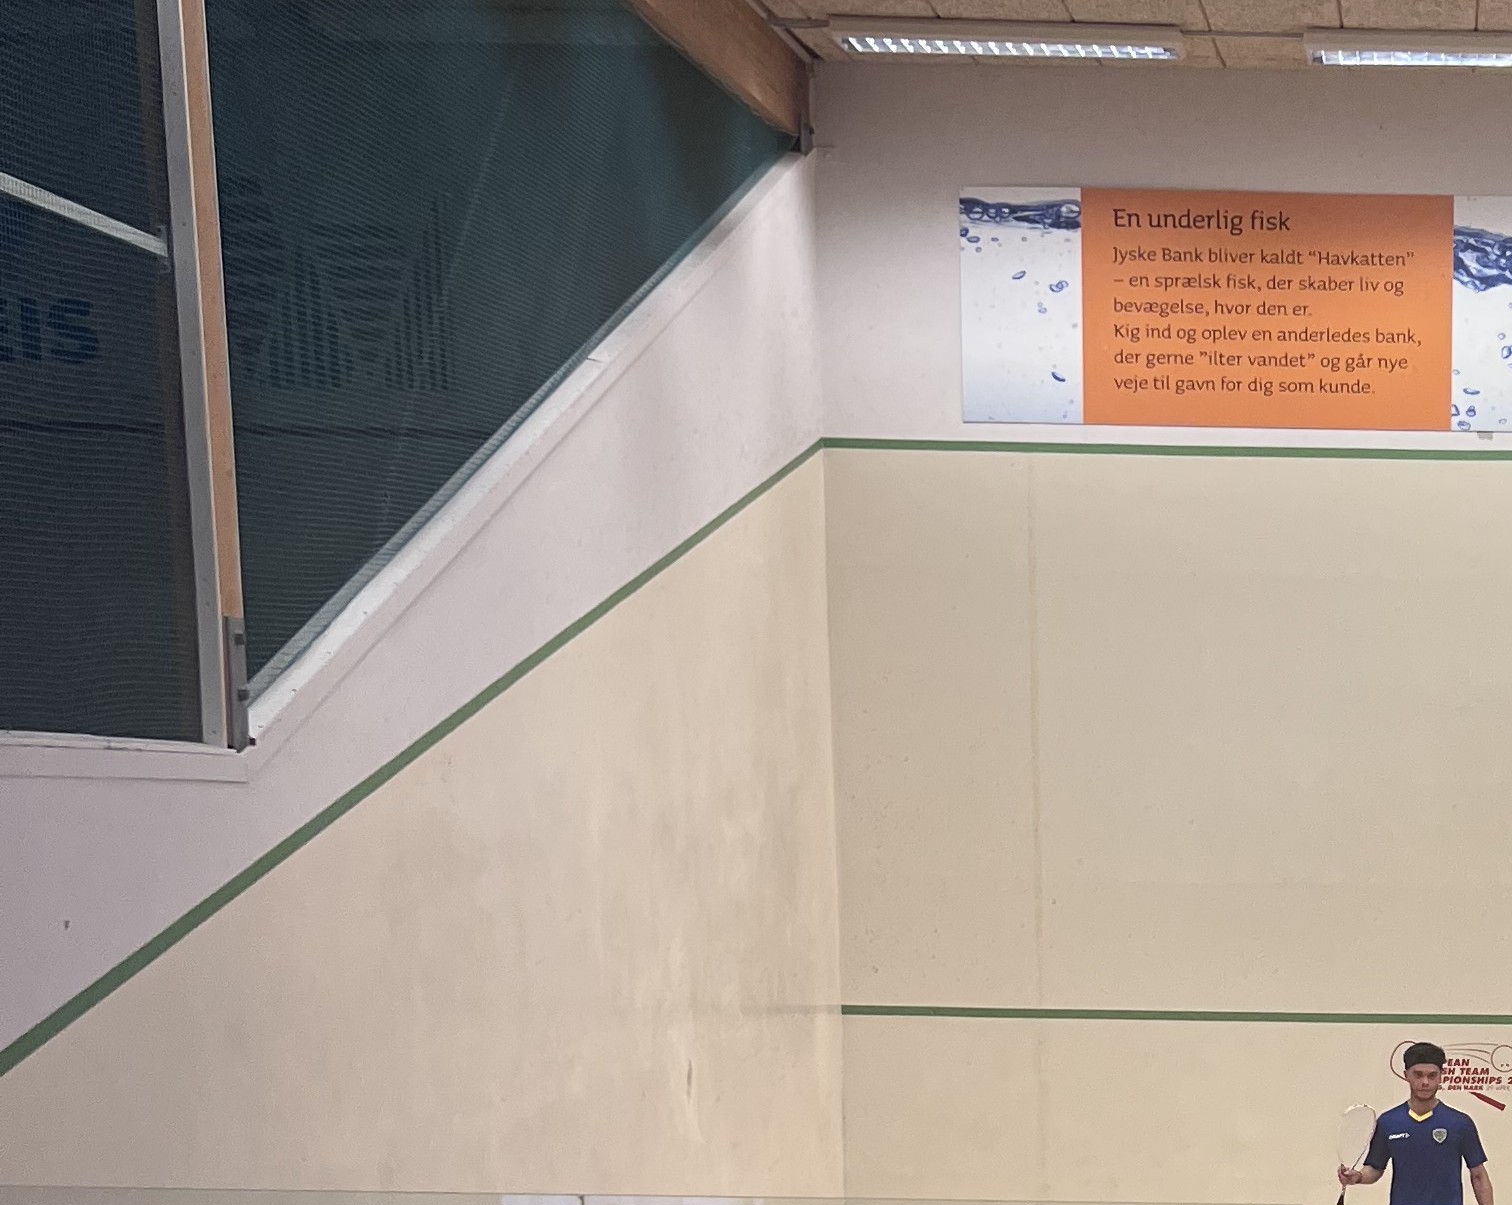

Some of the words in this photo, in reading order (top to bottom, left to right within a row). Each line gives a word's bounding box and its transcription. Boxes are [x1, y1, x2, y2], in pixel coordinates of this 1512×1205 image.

[1112, 208, 1142, 229] En
[1148, 208, 1244, 237] underlig
[1250, 209, 1291, 231] fisk
[1112, 246, 1157, 266] Jyske
[1162, 248, 1204, 263] Bank
[1208, 248, 1256, 264] bliver
[1260, 249, 1304, 265] kaldt
[1128, 275, 1149, 288] en
[1154, 273, 1222, 291] sprælsk
[1226, 273, 1262, 292] fisk,
[1266, 275, 1294, 291] der
[1299, 275, 1355, 292] skaber
[1359, 276, 1380, 292] liv
[1383, 280, 1405, 297] og
[1113, 297, 1211, 318] bevægelse,
[1215, 299, 1252, 315] hvor
[1256, 300, 1288, 316] den
[1292, 304, 1313, 317] er.
[1114, 323, 1141, 343] Kig
[1146, 323, 1172, 339] ind
[1176, 327, 1197, 344] og
[1201, 325, 1248, 344] oplev
[1252, 329, 1273, 342] en
[1277, 326, 1371, 343] anderledes
[1375, 327, 1422, 347] bank,
[1114, 349, 1142, 364] der
[1146, 351, 1195, 369] gerne
[1320, 356, 1341, 373] og
[1345, 352, 1373, 373] går
[1378, 356, 1409, 373] nye
[1114, 376, 1149, 393] veje
[1153, 375, 1170, 391] til
[1175, 378, 1217, 395] gavn
[1221, 375, 1244, 392] for
[1248, 376, 1274, 397] dig
[1279, 380, 1315, 394] som
[1319, 377, 1376, 395] kunde.
[1440, 1076, 1502, 1085] PIONSHIPS
[1459, 1067, 1490, 1076] TEAM
